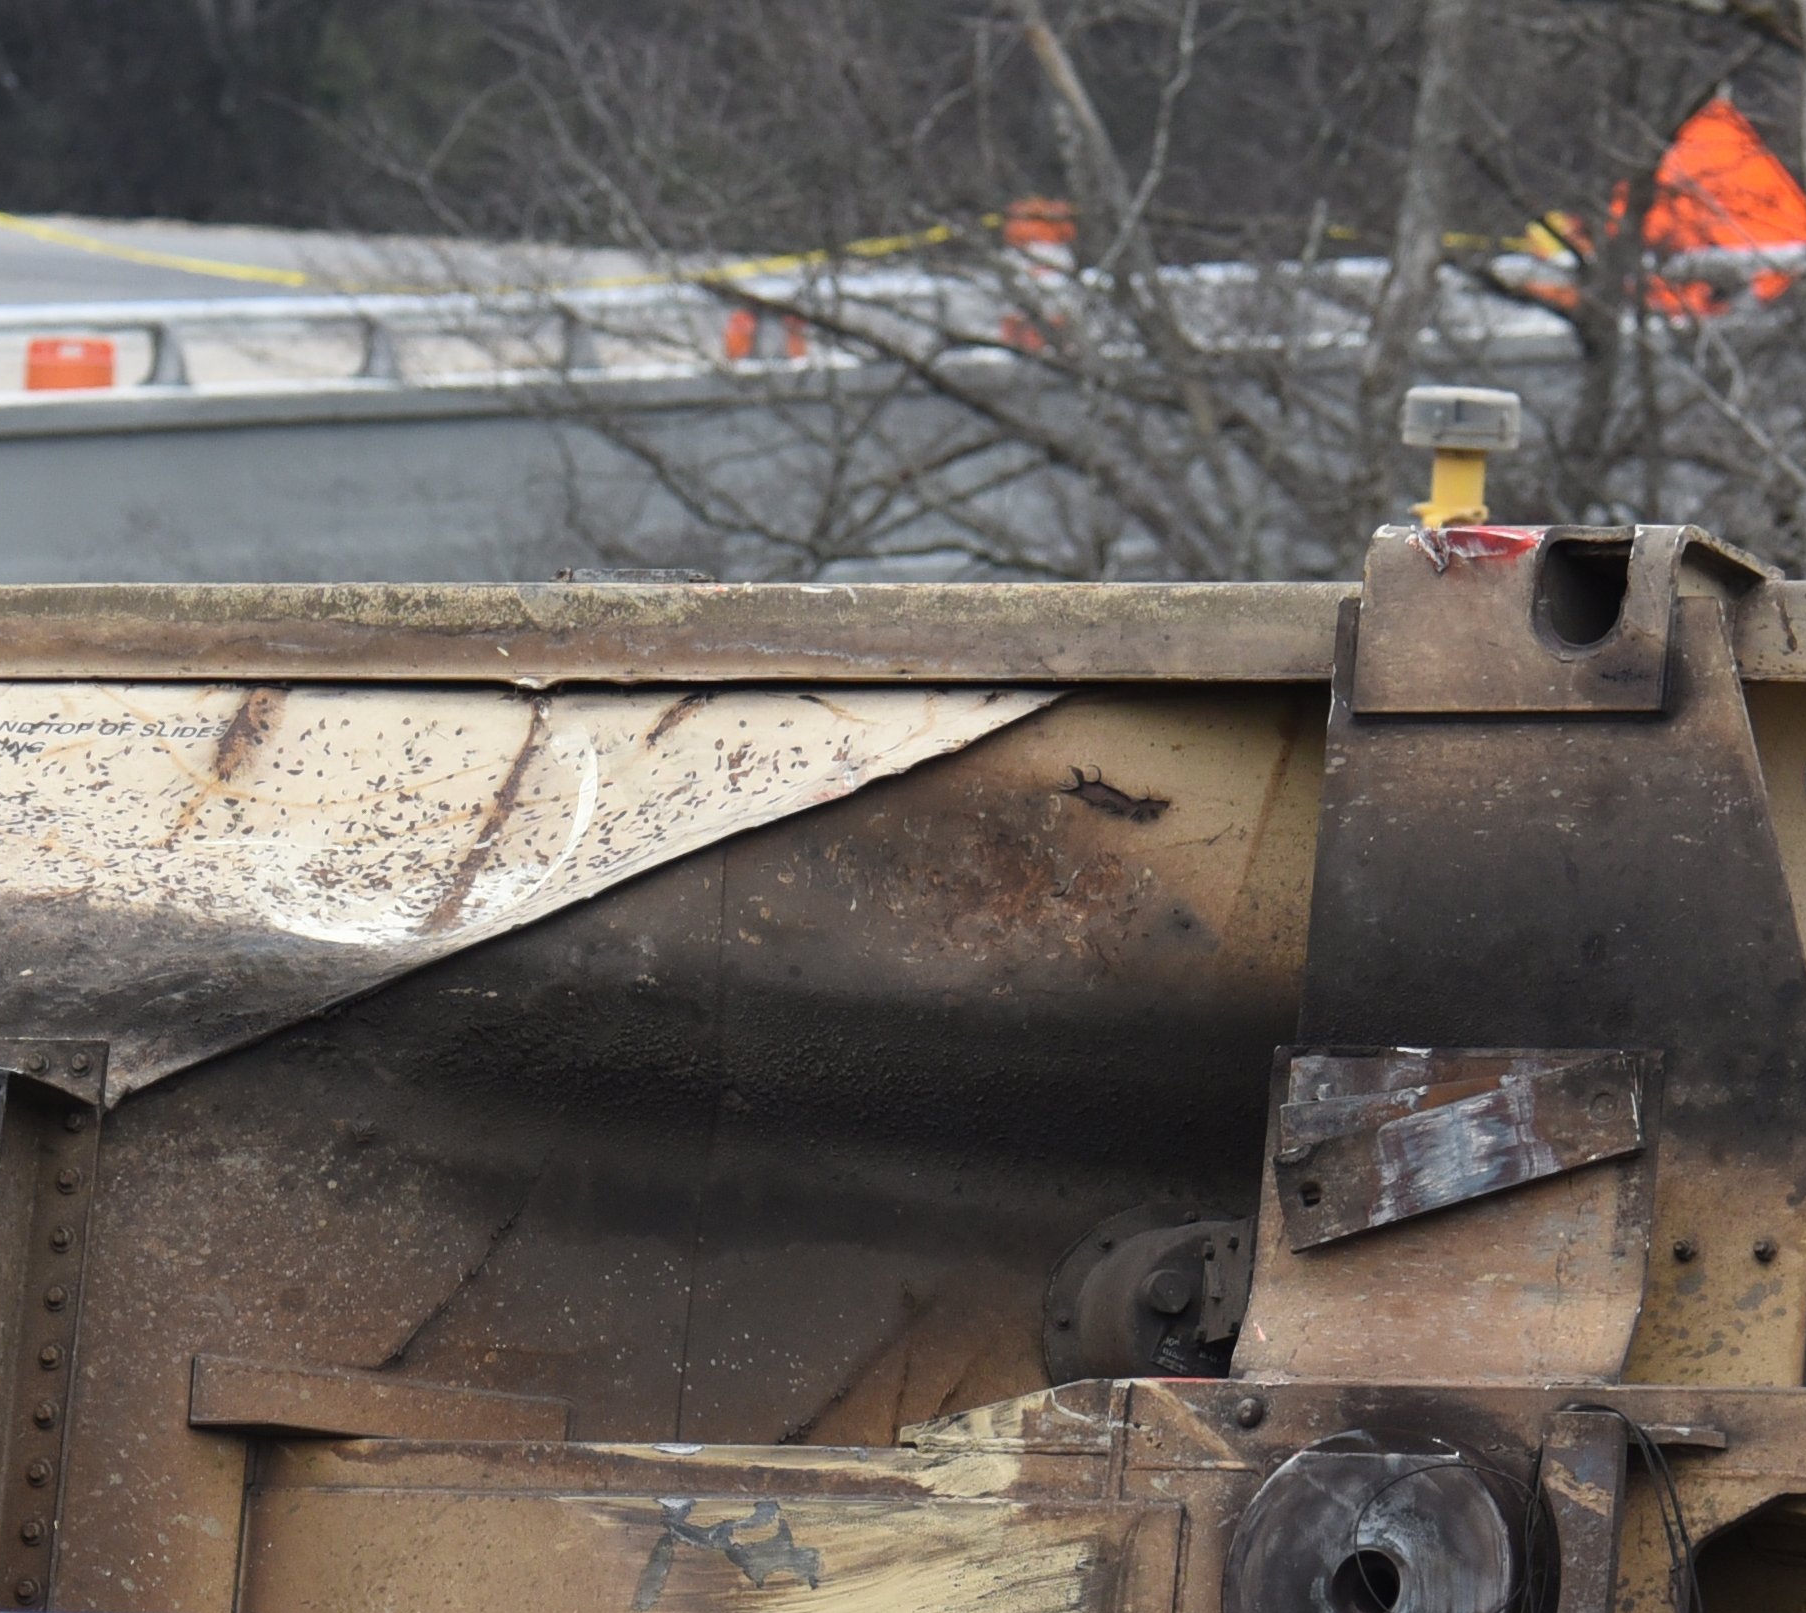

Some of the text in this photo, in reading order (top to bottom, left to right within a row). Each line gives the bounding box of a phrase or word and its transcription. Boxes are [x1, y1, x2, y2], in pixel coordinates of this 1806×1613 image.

[42, 721, 93, 736] TOP
[97, 721, 137, 737] OF
[138, 721, 230, 738] SLIDES
